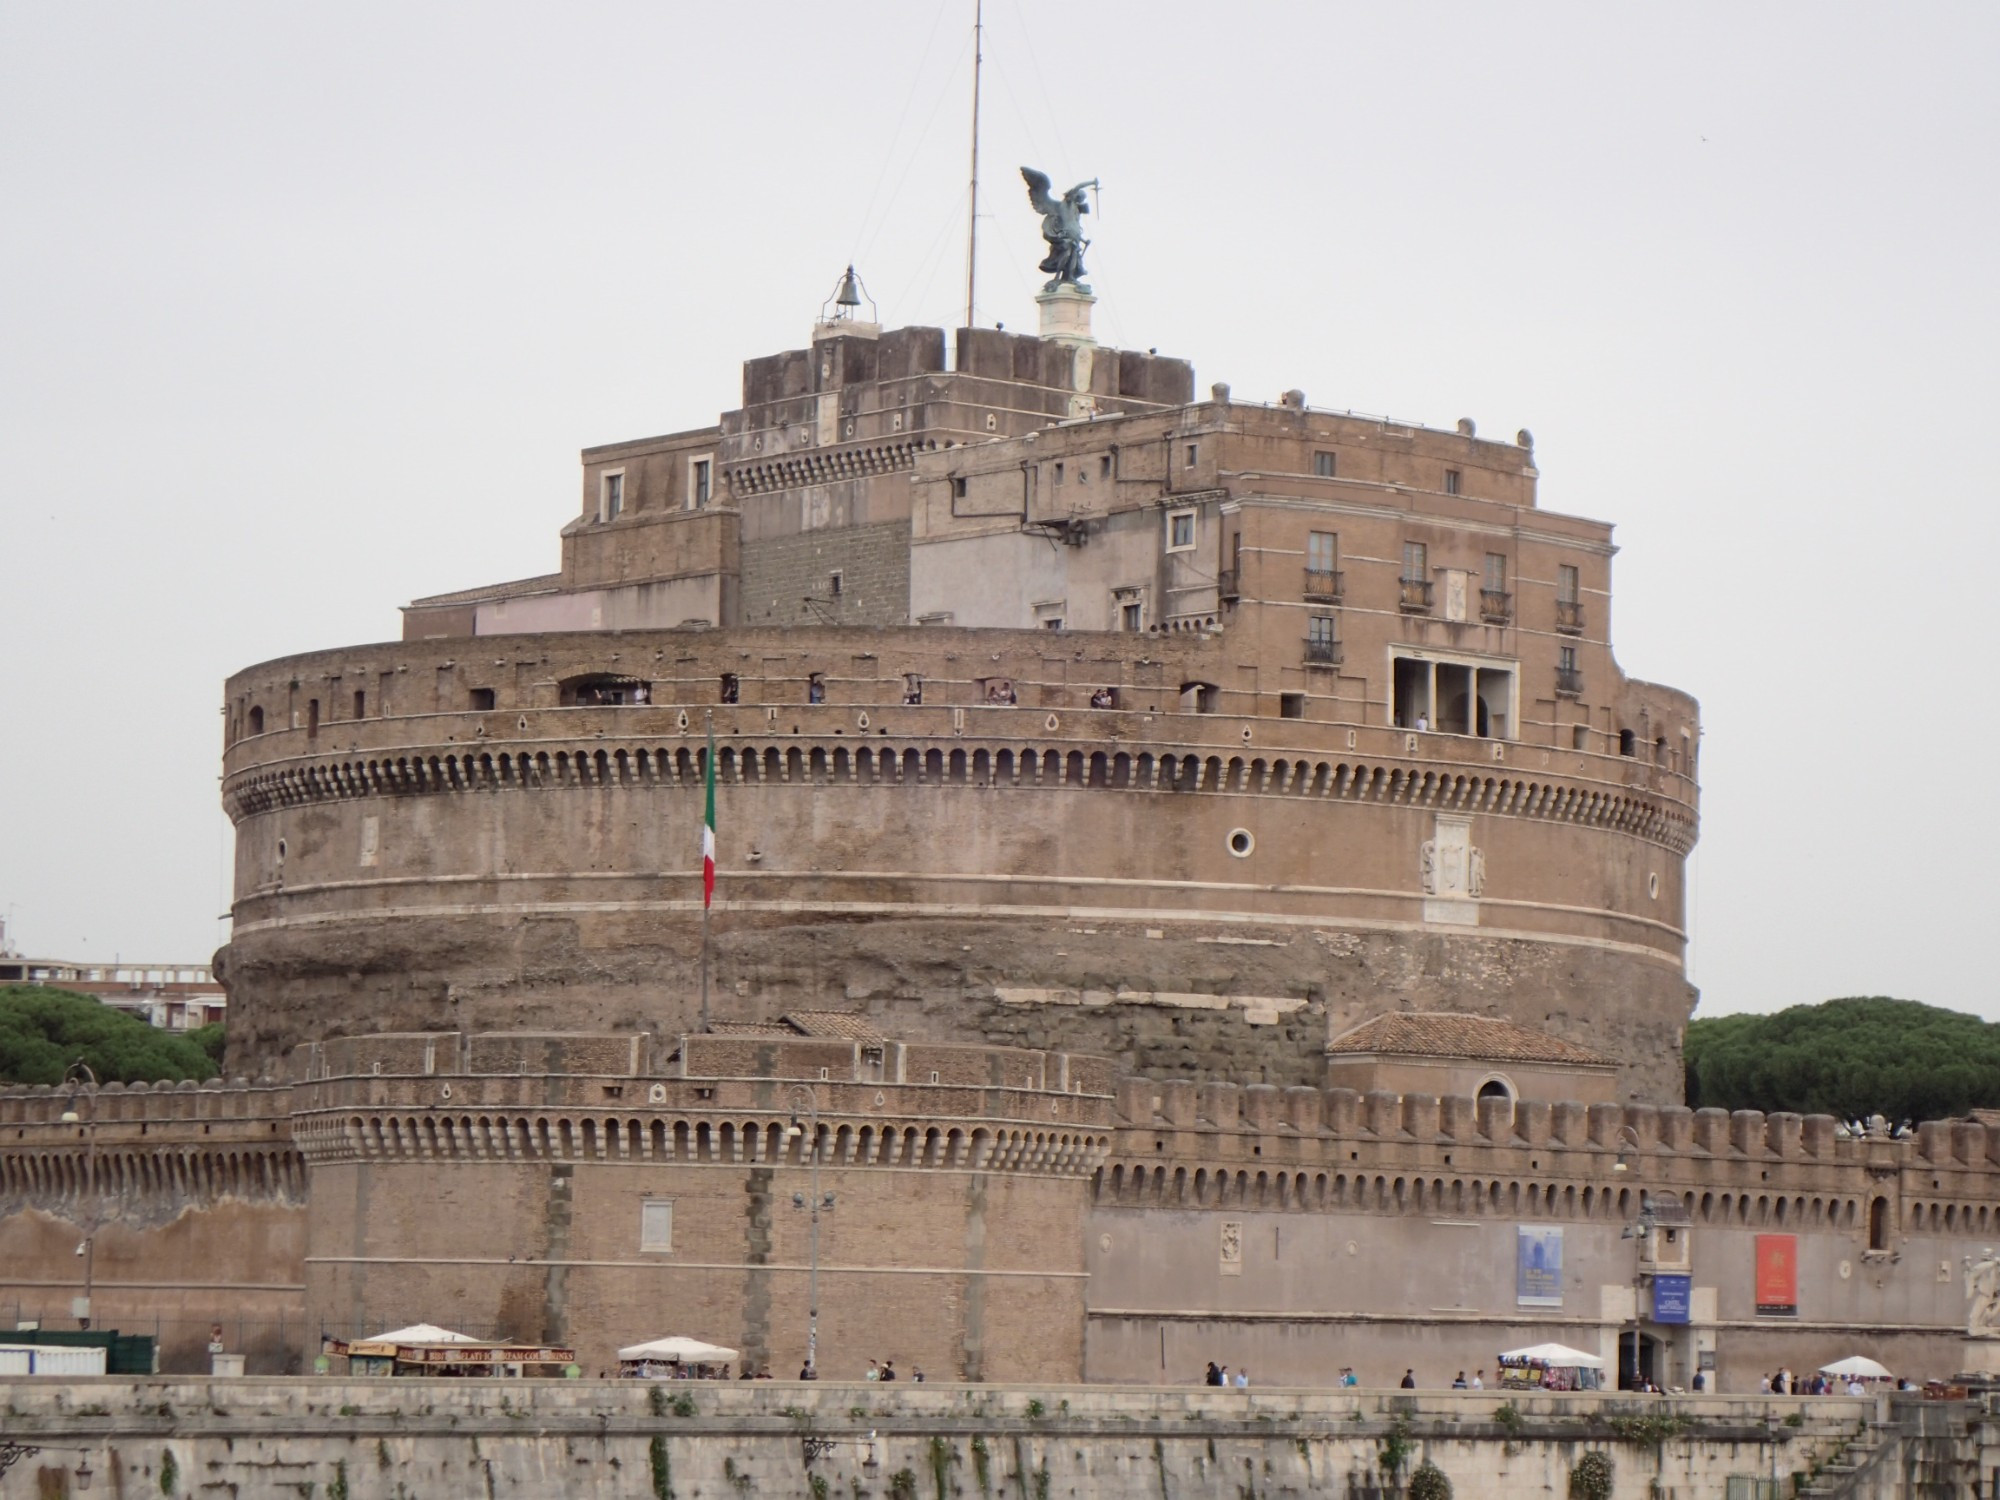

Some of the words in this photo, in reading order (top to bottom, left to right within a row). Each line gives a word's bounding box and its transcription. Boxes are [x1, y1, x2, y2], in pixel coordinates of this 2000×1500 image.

[457, 1351, 482, 1361] ELATI
[500, 1351, 523, 1361] REAM
[524, 1351, 543, 1361] COL
[548, 1351, 574, 1361] RINKS
